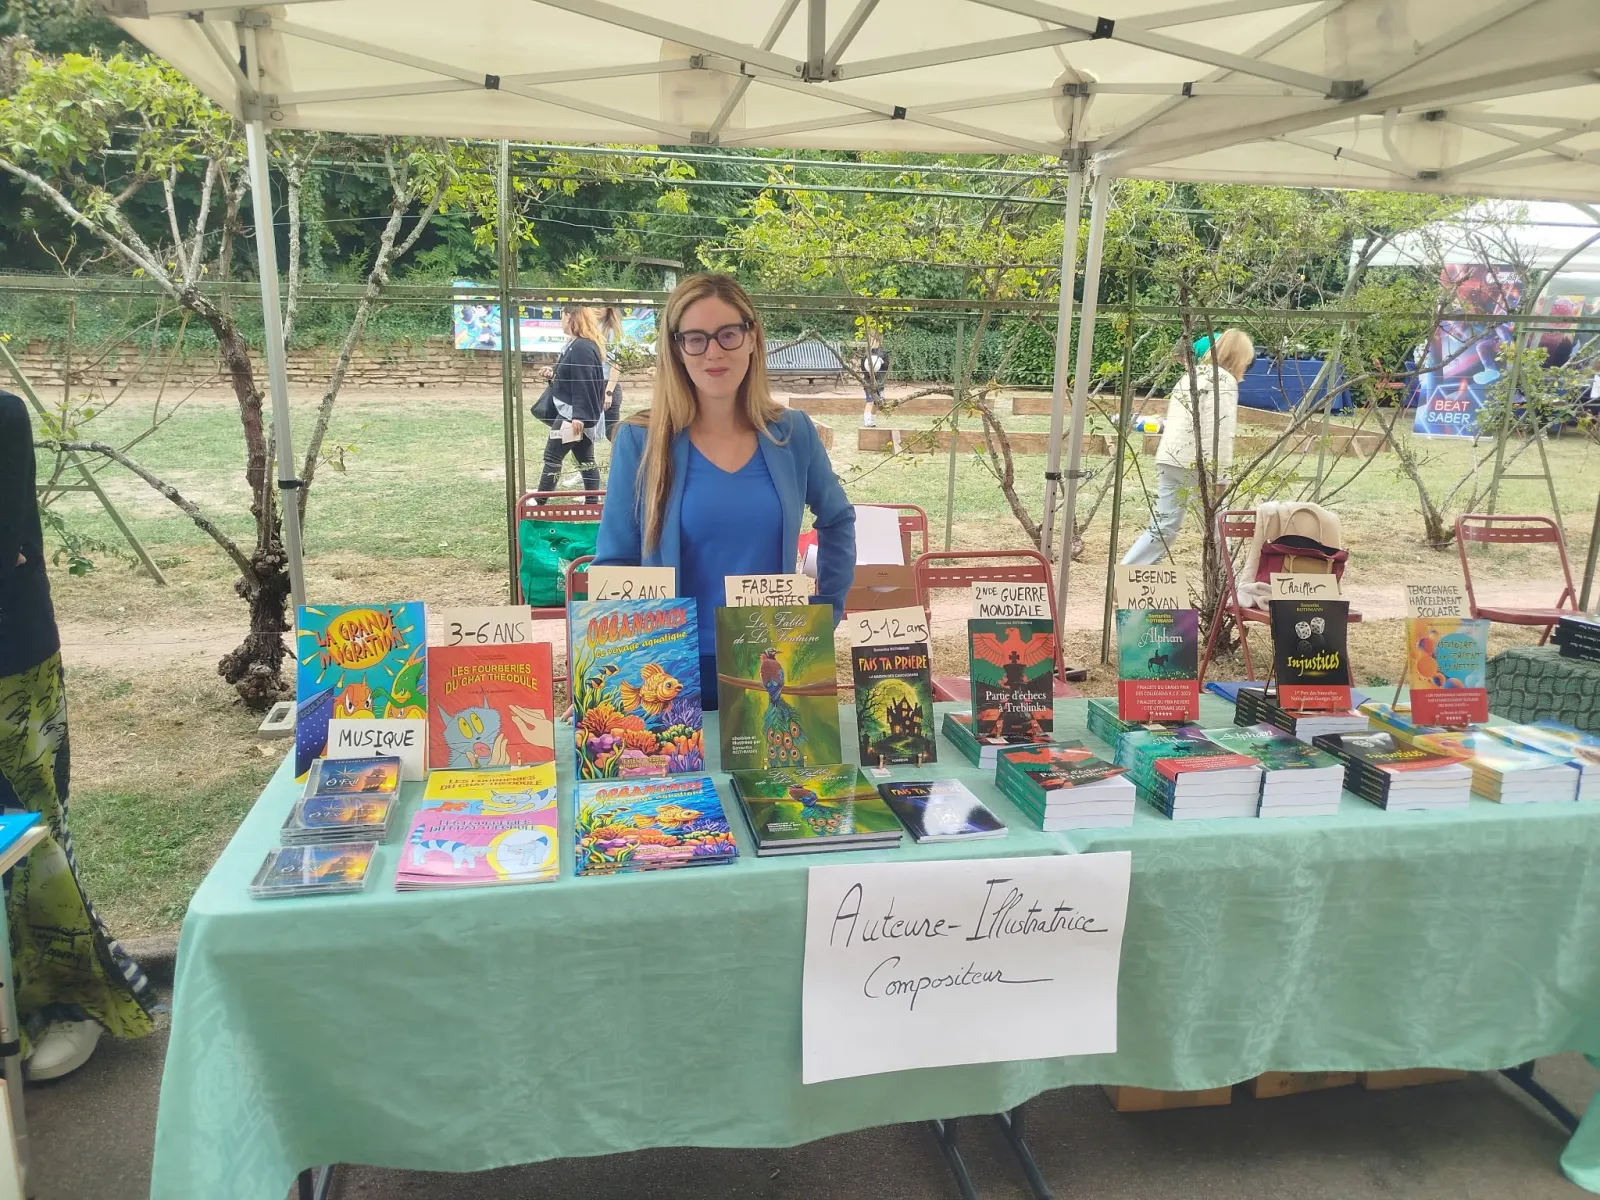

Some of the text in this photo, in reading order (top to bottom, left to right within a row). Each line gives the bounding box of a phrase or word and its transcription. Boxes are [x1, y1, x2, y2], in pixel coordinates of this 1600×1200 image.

[1435, 400, 1470, 411] BEAT
[1428, 411, 1470, 423] SABER
[1128, 570, 1177, 584] LEGENDE
[596, 580, 634, 600] 4-8
[638, 585, 667, 600] ANS
[742, 579, 793, 594] FABLES
[1141, 586, 1156, 596] DU
[1277, 578, 1326, 595] Thriller
[1407, 585, 1459, 595] TEMOIGNAGE
[976, 587, 1047, 602] 2NDE GUERRE
[1409, 596, 1462, 605] HARCELEMENT
[980, 604, 1045, 617] MONDIALE
[1128, 596, 1179, 610] MORVAN
[1417, 606, 1461, 618] SCOLAIRE
[745, 611, 807, 629] Les Fables
[315, 609, 395, 648] LA GRANDE
[448, 622, 525, 646] 3-6 ANS
[860, 618, 928, 643] 9-12 ans
[608, 643, 639, 656] voyage
[642, 631, 687, 648] aquatique
[733, 628, 819, 645] de La Fontaine
[320, 628, 406, 670] MIGRATION
[451, 663, 531, 678] LES FOURBERIES
[858, 657, 877, 671] FAIS
[879, 657, 892, 671] TA
[1287, 650, 1340, 676] Injustices
[445, 673, 538, 694] DU CHAT THEODULE
[985, 690, 1046, 701] Partie d'échecs
[998, 702, 1047, 713] à Treblinka
[338, 729, 415, 747] MUSIQUE
[863, 955, 1054, 1011] Compositeur
